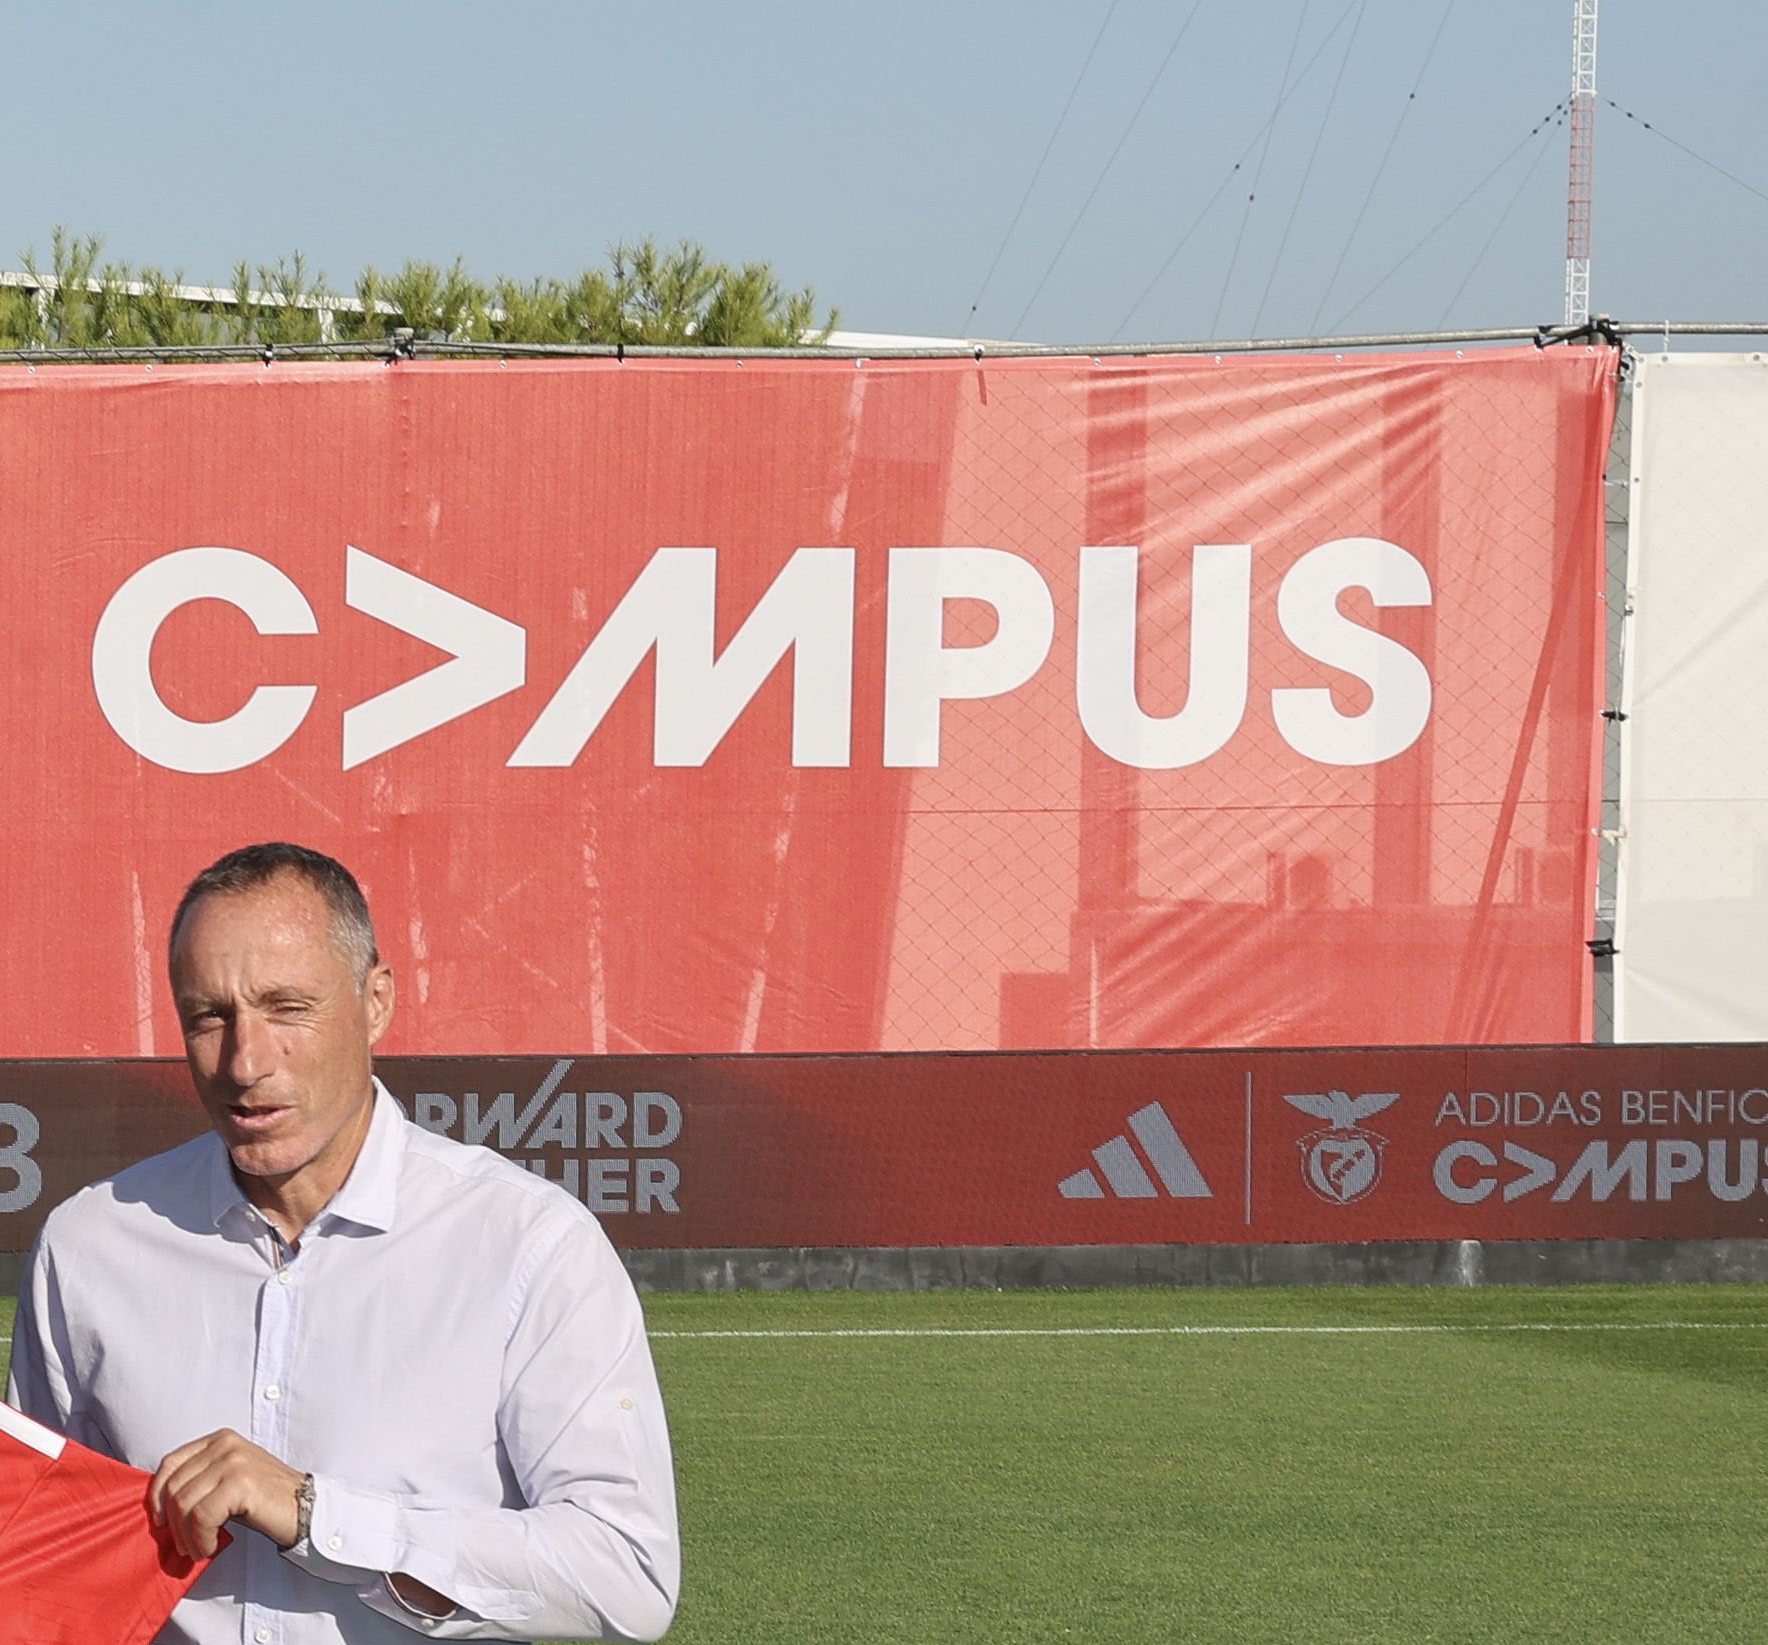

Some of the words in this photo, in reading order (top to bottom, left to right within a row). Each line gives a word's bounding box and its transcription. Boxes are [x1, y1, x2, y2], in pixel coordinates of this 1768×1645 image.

[393, 1059, 683, 1150] RWARD
[1435, 1090, 1602, 1126] ADIDAS
[1621, 1087, 1768, 1126] BENFIC
